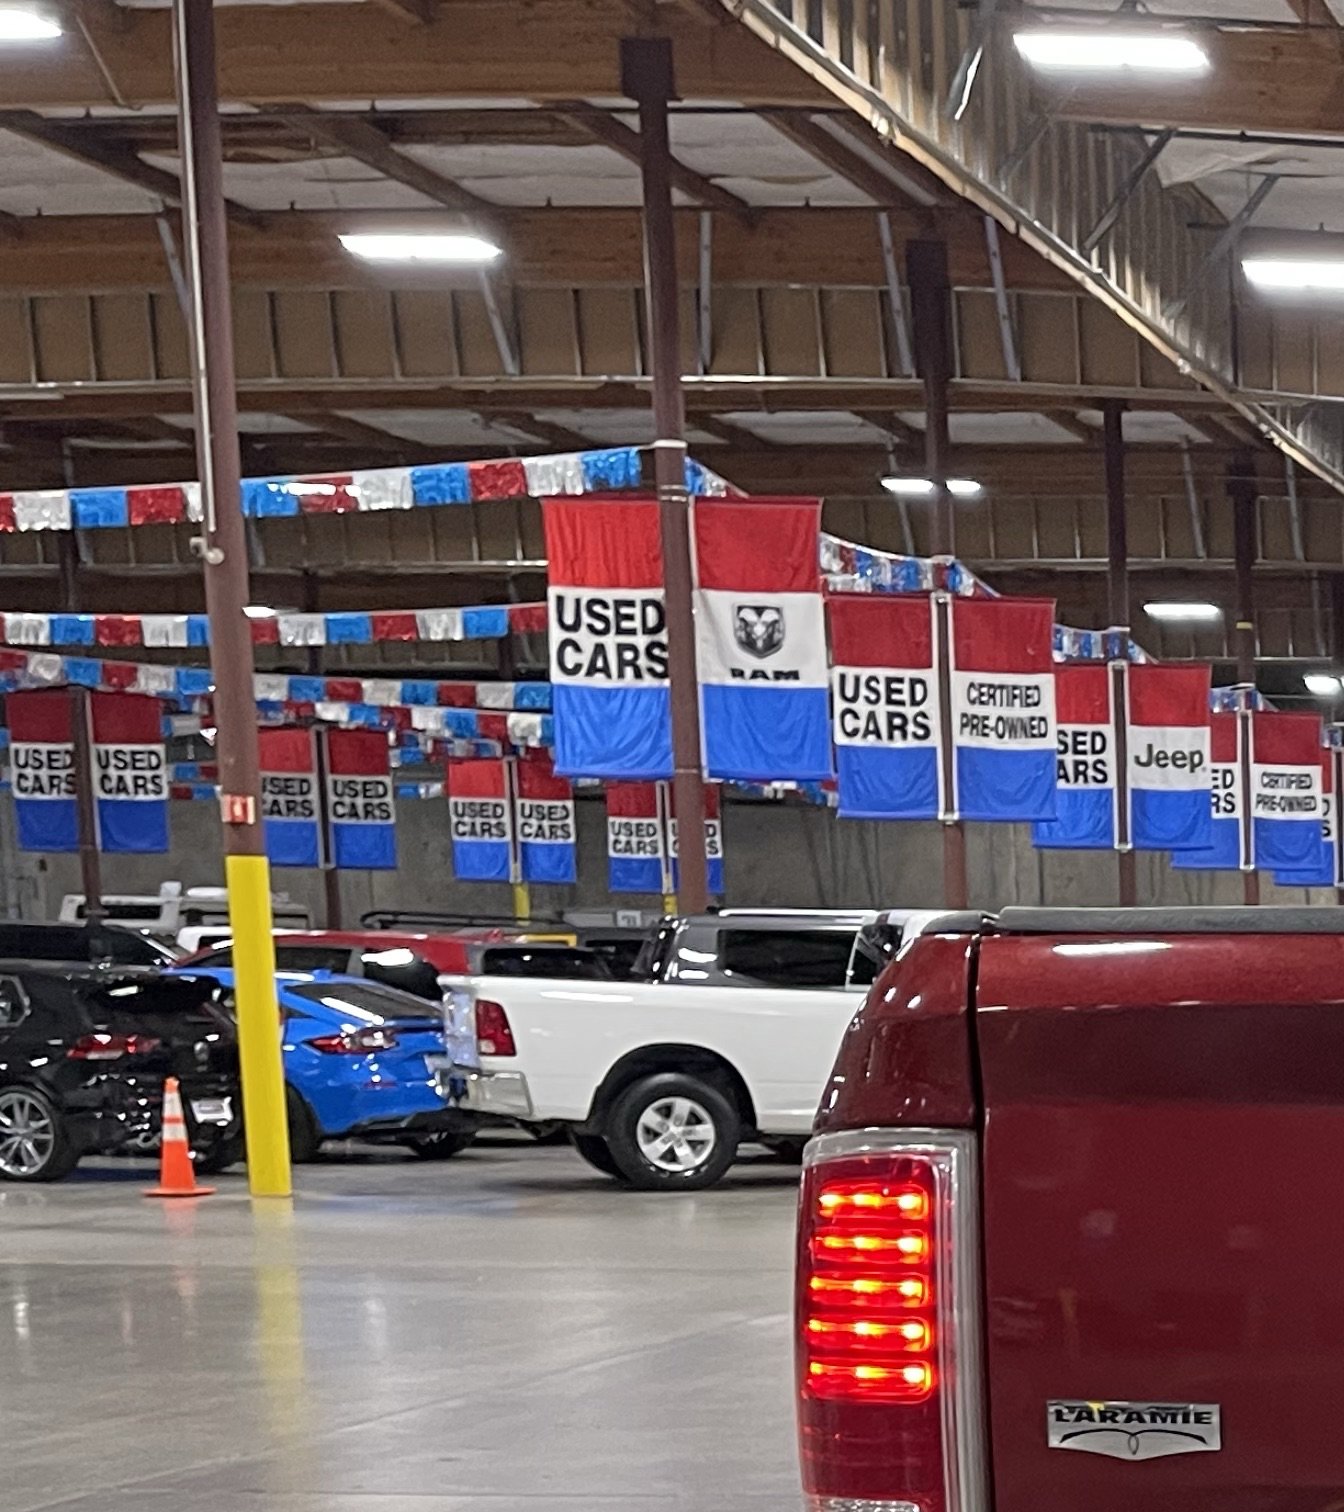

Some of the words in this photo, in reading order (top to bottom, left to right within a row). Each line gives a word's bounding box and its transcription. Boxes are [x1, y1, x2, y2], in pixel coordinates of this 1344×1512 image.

[556, 596, 666, 636] USED
[557, 638, 668, 680] CARS
[731, 668, 800, 680] RAM
[839, 674, 928, 707] USED
[967, 682, 1041, 708] CERTIFIED
[840, 708, 931, 741] CARS
[960, 713, 1048, 739] PRE-OWNED
[1057, 730, 1106, 755] SED
[14, 749, 72, 770] USED
[97, 750, 161, 770] USED
[1134, 744, 1203, 773] Jeep
[1057, 760, 1108, 784] ARS
[17, 773, 77, 795] CARS
[100, 774, 163, 795] CARS
[332, 780, 388, 799] USED
[262, 800, 314, 818] ARS
[332, 801, 391, 820] CARS
[453, 802, 505, 819] USED
[520, 803, 569, 820] USED
[454, 822, 506, 838] CARS
[520, 822, 572, 840] CARS
[610, 821, 656, 837] USED
[612, 839, 659, 855] CARS
[1054, 1408, 1213, 1425] LARAMIE
